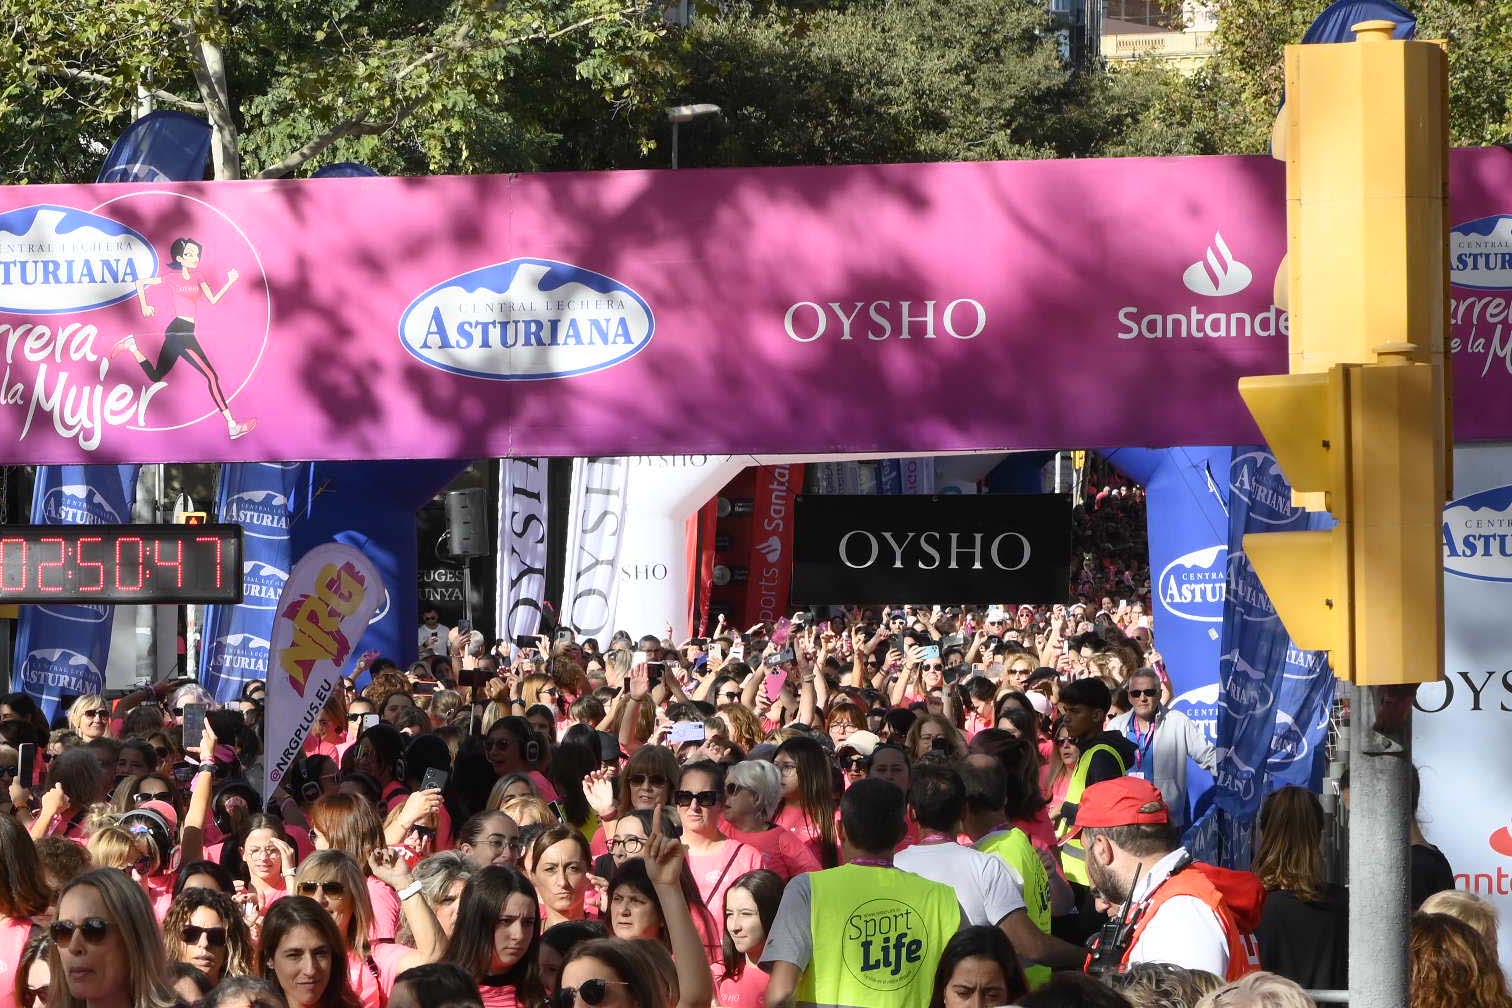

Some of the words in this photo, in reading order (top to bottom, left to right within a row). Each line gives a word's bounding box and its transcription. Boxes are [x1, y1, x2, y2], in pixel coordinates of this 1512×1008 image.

[420, 306, 635, 350] ASTURIANA
[458, 299, 538, 314] CENTRAL
[544, 298, 626, 312] LECHERA
[784, 298, 988, 342] OYSHO
[0, 366, 25, 407] la
[19, 357, 169, 451] Mujer
[0, 536, 223, 592] 02:50:47
[839, 530, 1032, 571] OYSHO
[271, 679, 332, 783] @NRGPLUS.EU
[849, 908, 912, 941] Sport
[861, 932, 923, 976] Life
